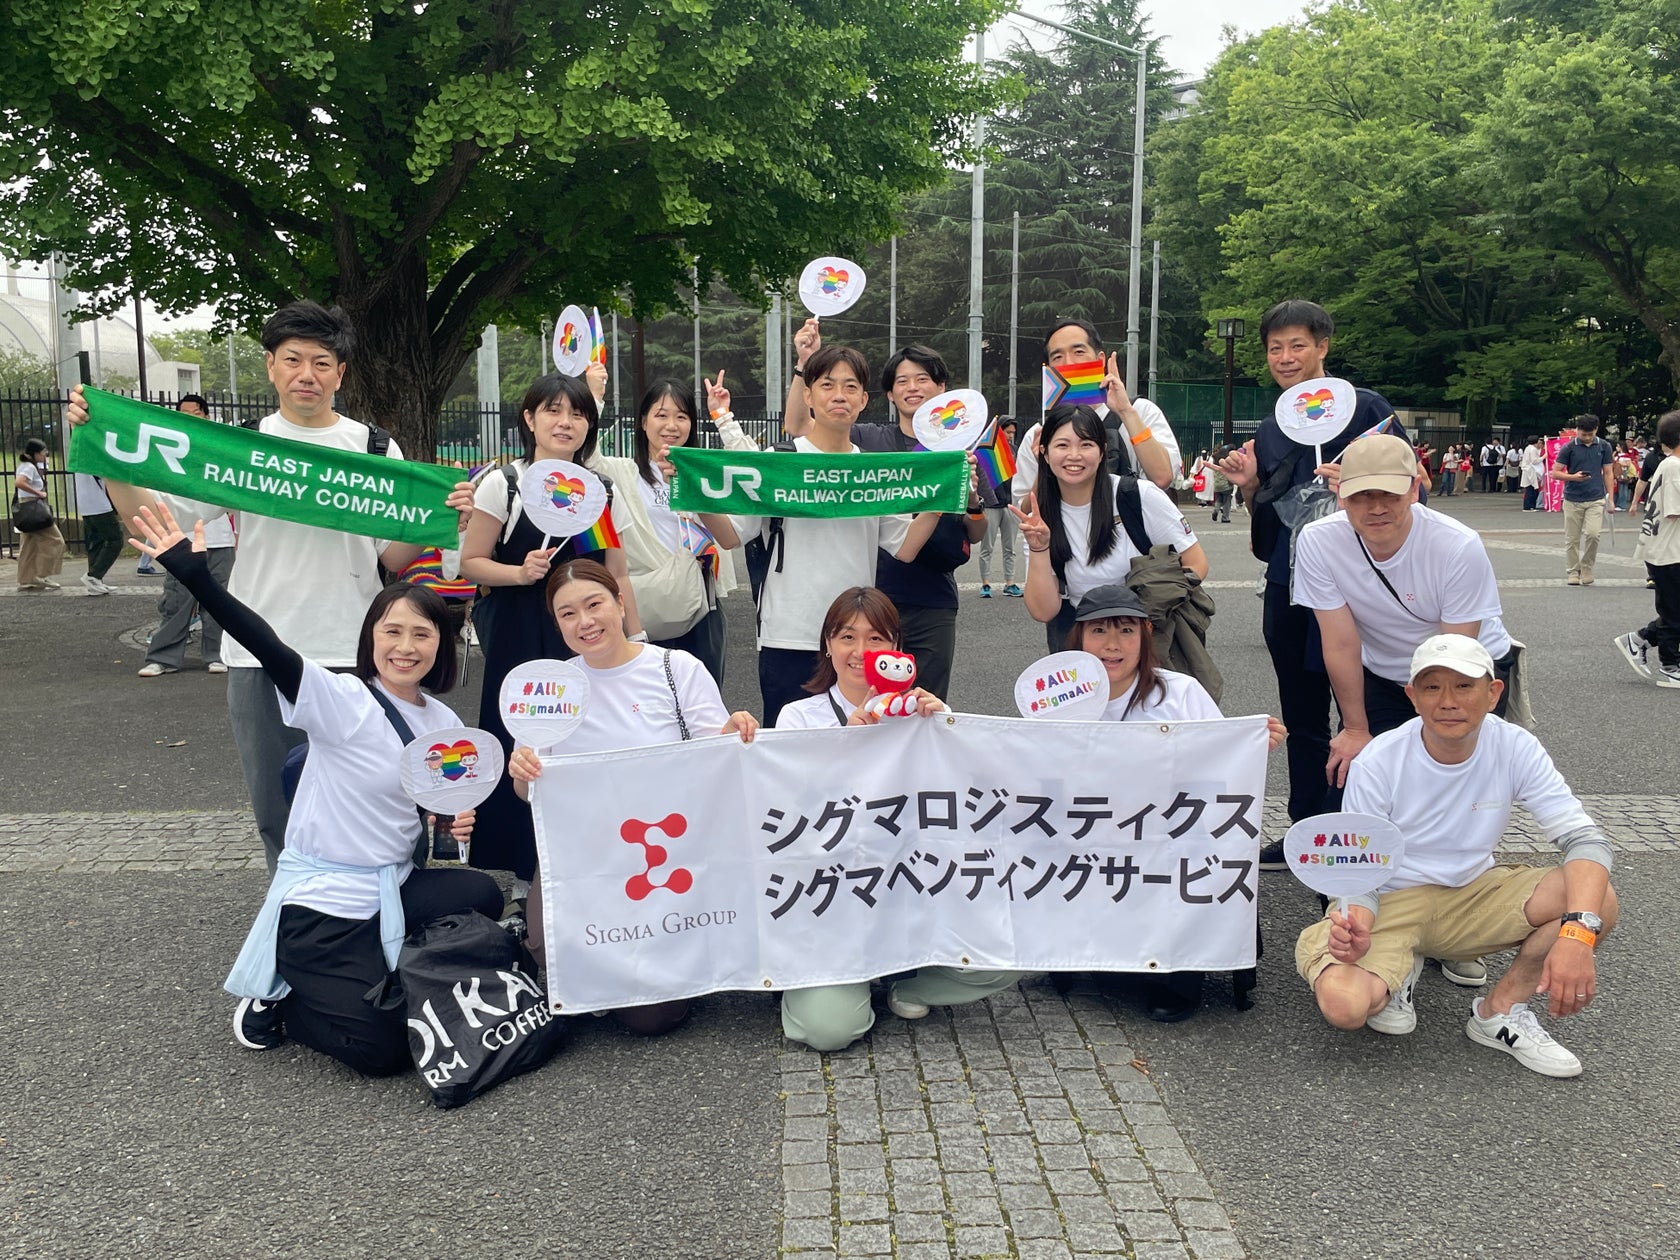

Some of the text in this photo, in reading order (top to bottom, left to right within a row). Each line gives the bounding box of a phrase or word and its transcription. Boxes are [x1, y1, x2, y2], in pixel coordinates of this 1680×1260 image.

[104, 423, 190, 474] JR
[250, 450, 395, 496] EAST JAPAN
[701, 465, 763, 502] JR
[803, 468, 913, 484] EAST JAPAN
[203, 463, 433, 525] RAILWAY COMPANY
[774, 483, 941, 504] RAILWAY COMPANY
[958, 474, 968, 509] BASEBALL
[523, 682, 566, 699] #Ally
[1035, 668, 1077, 693] #Ally
[509, 702, 580, 716] #SigmaAlly
[761, 791, 1259, 854] シグマロジスティクス
[1313, 833, 1370, 849] #Ally
[1298, 853, 1390, 866] #SigmaAlly
[764, 848, 1256, 922] シグマベンディングサービス
[1565, 928, 1576, 937] 16
[481, 1000, 553, 1051] COFFEE
[1495, 1025, 1520, 1047] N
